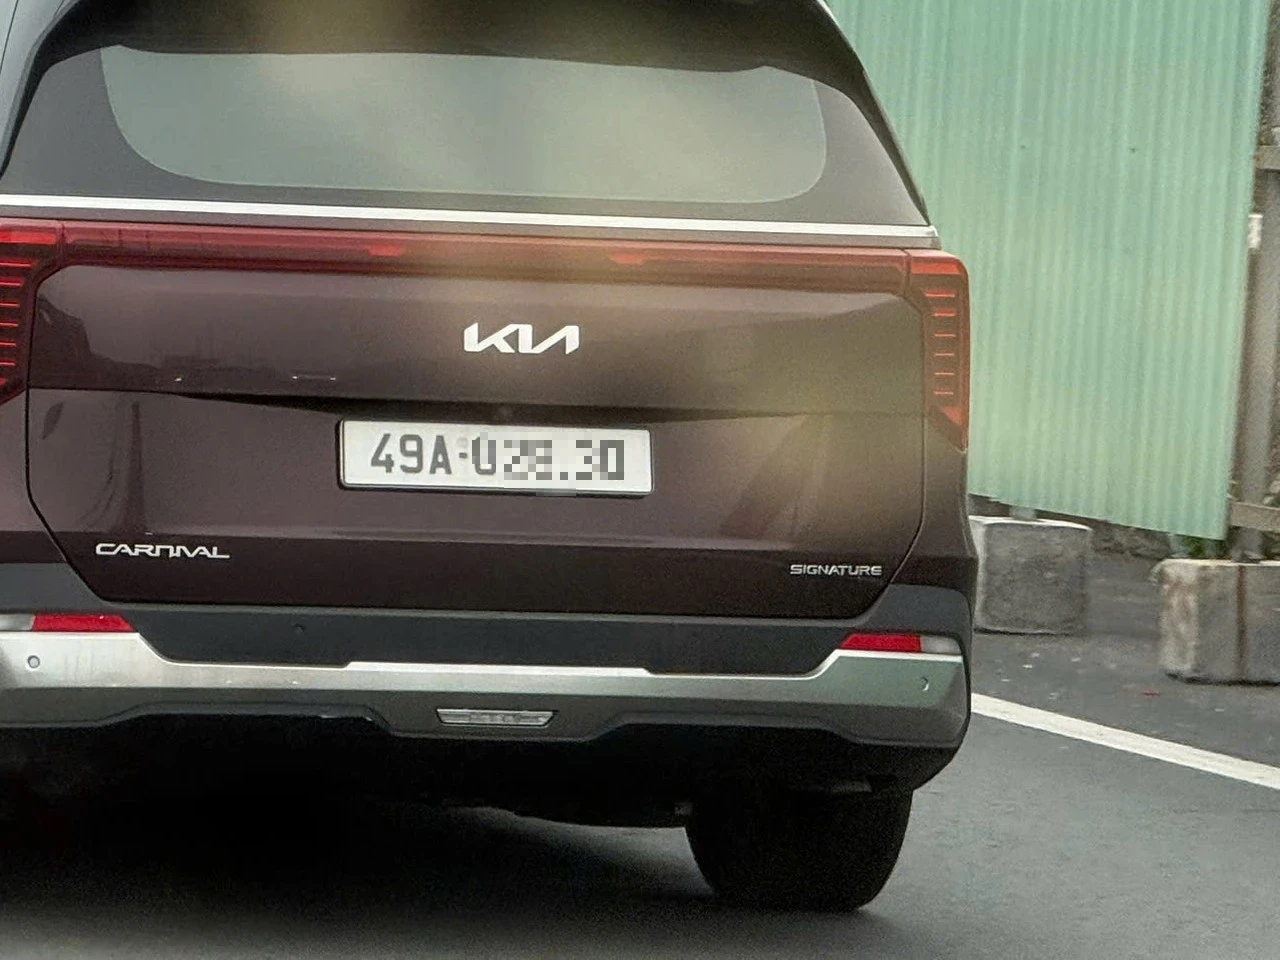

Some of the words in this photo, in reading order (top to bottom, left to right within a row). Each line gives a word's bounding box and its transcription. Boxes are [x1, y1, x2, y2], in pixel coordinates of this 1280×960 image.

[463, 322, 580, 355] KIA
[95, 542, 231, 559] CARNIVAL
[789, 564, 883, 577] SIGNATURE
